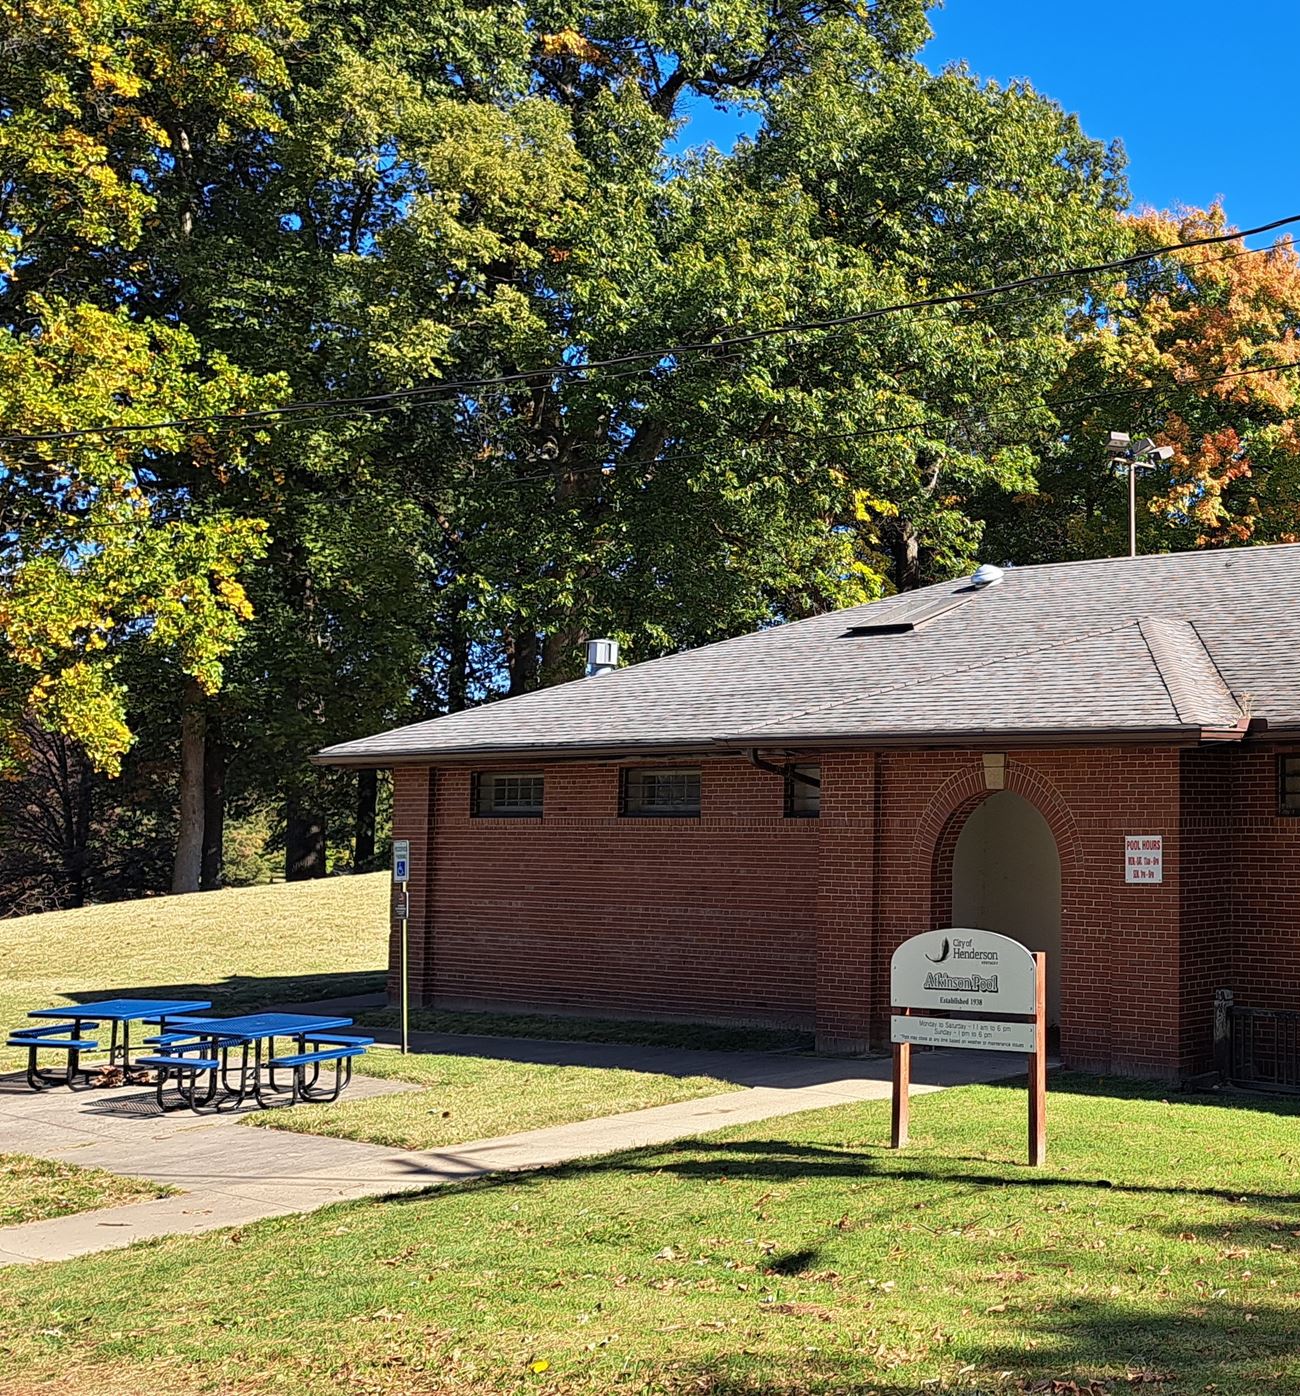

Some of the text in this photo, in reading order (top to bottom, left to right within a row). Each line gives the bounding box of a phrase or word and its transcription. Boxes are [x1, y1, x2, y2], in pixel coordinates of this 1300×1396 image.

[1127, 840, 1160, 850] POOL HOURS
[953, 938, 973, 949] City of
[953, 947, 998, 960] Henderson
[924, 972, 999, 993] Atkinson Pool
[940, 997, 983, 1006] Established 1938
[919, 1020, 937, 1028] Monday
[945, 1022, 967, 1030] Saturday
[934, 1028, 952, 1036] Sunday
